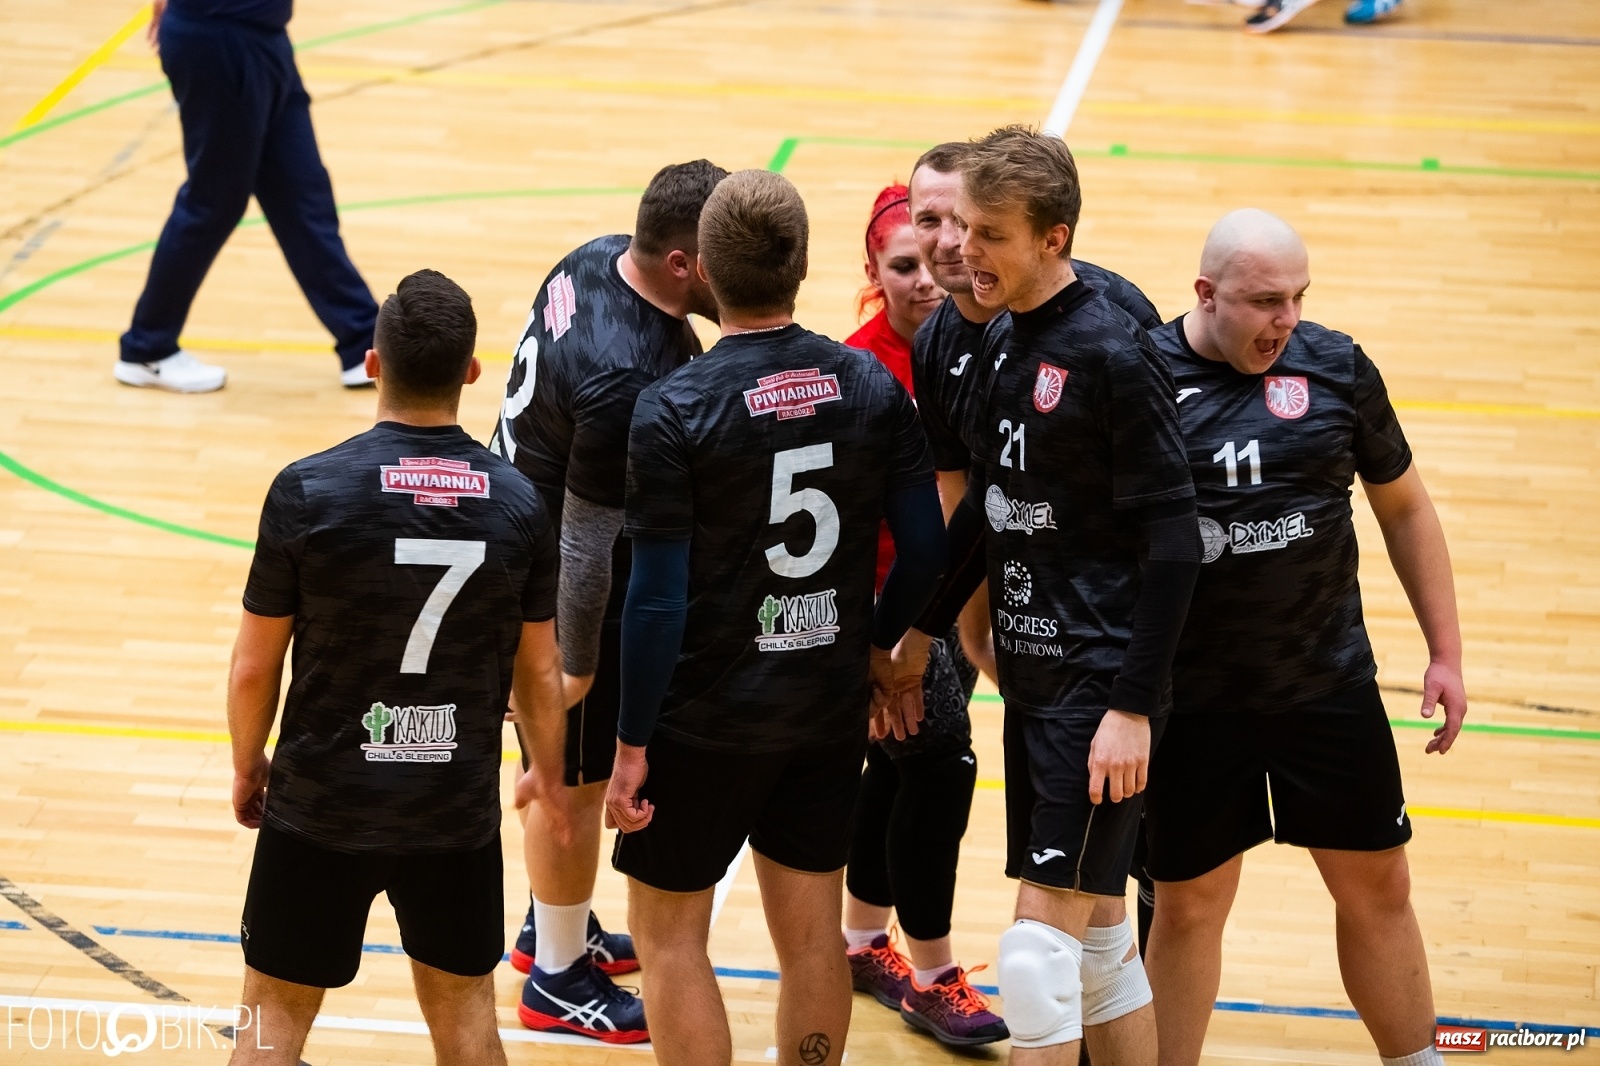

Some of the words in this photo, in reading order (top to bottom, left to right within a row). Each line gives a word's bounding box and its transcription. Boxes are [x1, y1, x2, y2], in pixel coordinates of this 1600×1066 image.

[752, 381, 835, 408] PIWIARNIA
[998, 418, 1026, 472] 21
[1213, 439, 1263, 487] 11
[389, 472, 483, 491] PIWIARNIA
[764, 442, 840, 578] 5
[1230, 512, 1314, 548] DYMEL
[394, 537, 486, 675] 7
[782, 590, 837, 632] KAKTUS
[760, 642, 786, 650] CHILL
[796, 635, 834, 647] SLEEPING
[394, 704, 456, 743] KAKTUS
[367, 752, 395, 760] CHILL
[396, 752, 403, 760] &
[405, 753, 450, 761] SLEEPING
